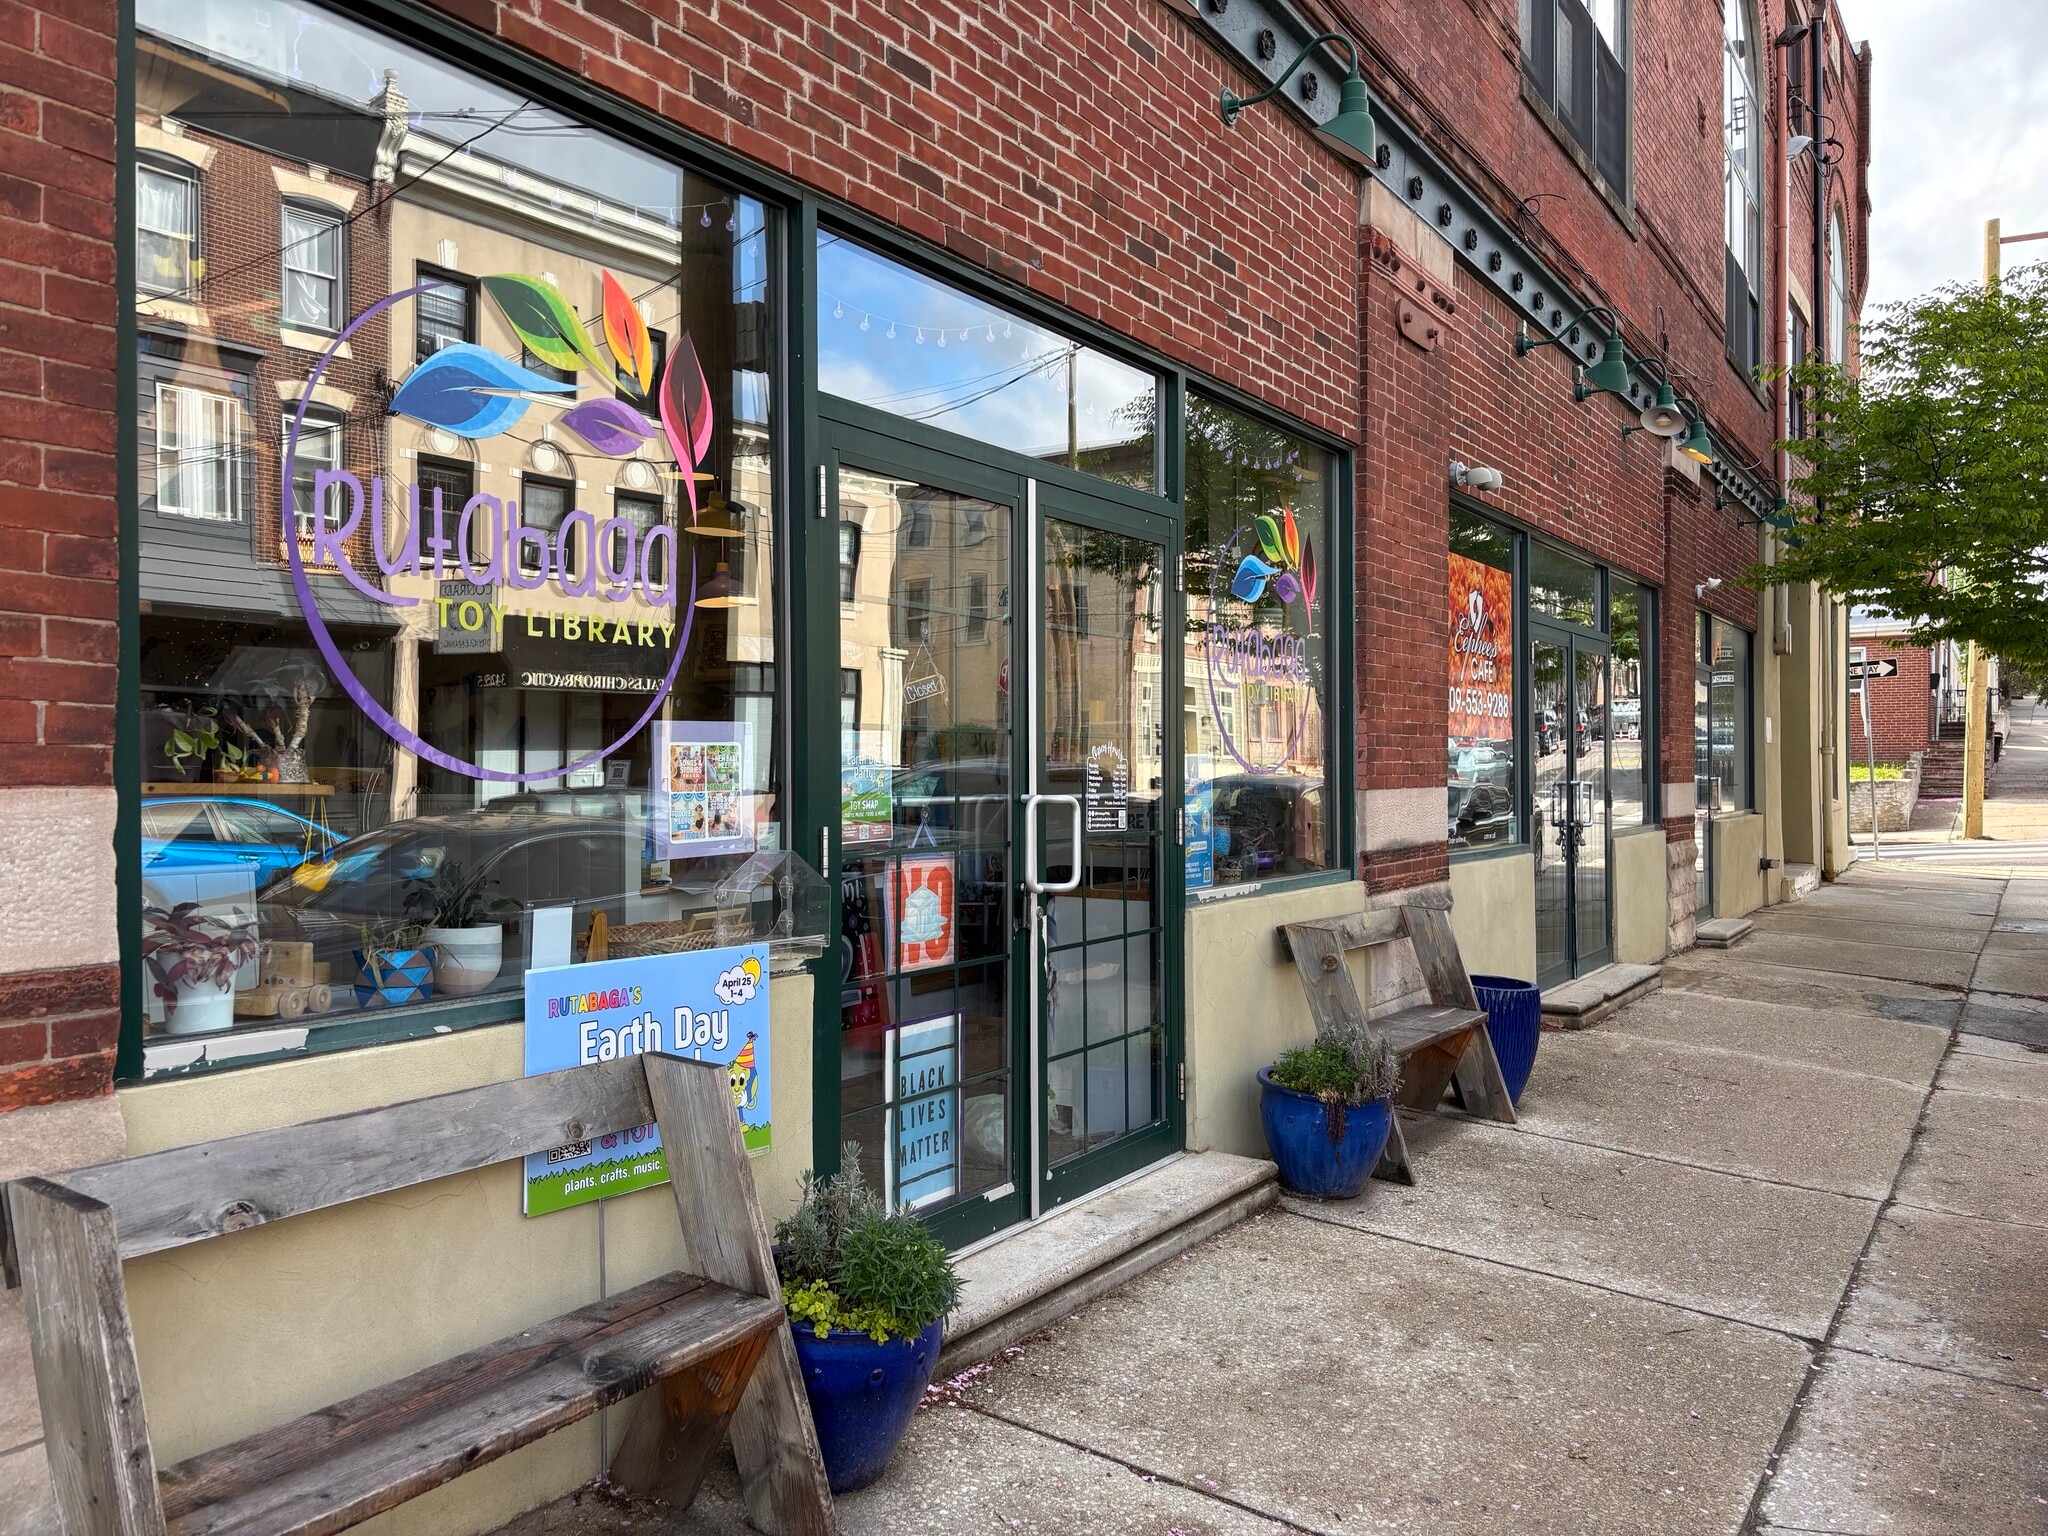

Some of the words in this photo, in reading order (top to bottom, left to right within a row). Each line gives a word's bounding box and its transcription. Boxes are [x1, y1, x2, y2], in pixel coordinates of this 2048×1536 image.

[314, 469, 677, 609] Rutabaga
[434, 597, 509, 631] TOY
[526, 608, 676, 649] LIBRARY
[1212, 623, 1306, 689] Rutabaga
[1471, 657, 1493, 683] CAFE
[906, 678, 938, 701] Closed
[1449, 686, 1509, 719] 09-553-9288
[850, 801, 861, 811] TOY
[862, 800, 879, 810] SWAP
[722, 977, 741, 990] April
[741, 976, 752, 986] 25
[731, 989, 744, 999] 1-4
[548, 985, 643, 1019] RUTABAGA'S
[579, 1011, 663, 1066] Earth
[673, 1005, 730, 1051] Day
[900, 1064, 945, 1098] BLACK
[900, 1098, 946, 1133] LIVES
[900, 1130, 950, 1168] MATTER
